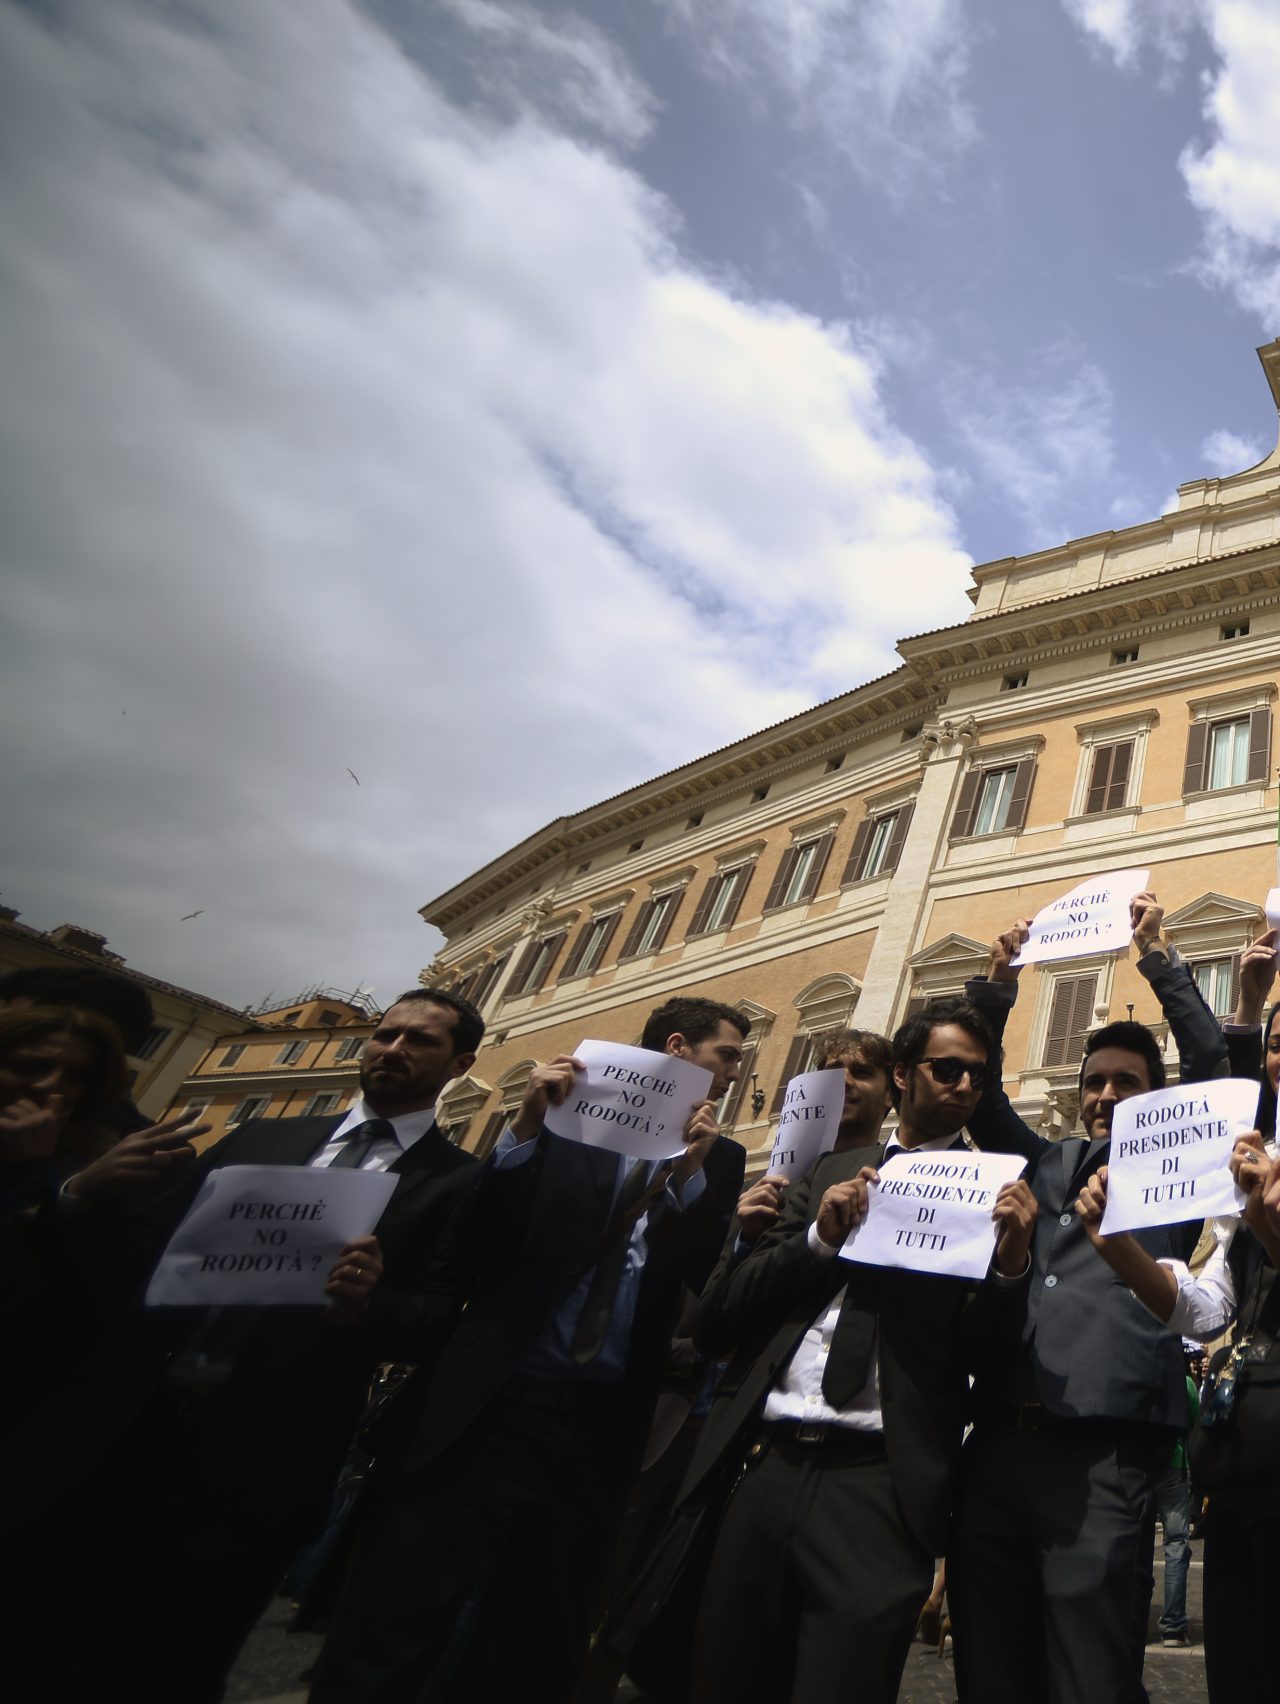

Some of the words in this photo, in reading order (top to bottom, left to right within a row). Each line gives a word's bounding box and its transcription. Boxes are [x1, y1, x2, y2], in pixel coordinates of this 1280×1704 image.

[1053, 889, 1111, 912] PERCHÈ
[1067, 911, 1089, 925] NO
[1040, 922, 1099, 945] RODOTÀ
[601, 1065, 677, 1098] PERCHÈ
[617, 1090, 646, 1108] NO
[574, 1100, 652, 1134] RODOTÀ
[655, 1124, 665, 1137] ?
[1135, 1094, 1210, 1130] RODOTÀ
[1119, 1119, 1229, 1159] PRESIDENTE
[907, 1162, 980, 1182] RODOTÀ
[1161, 1156, 1180, 1176] DI
[879, 1180, 991, 1206] PRESIDENTE
[1141, 1180, 1196, 1205] TUTTI
[227, 1199, 327, 1221] PERCHÈ
[916, 1207, 936, 1224] DI
[252, 1228, 287, 1246] NO
[895, 1229, 947, 1251] TUTTI
[200, 1251, 303, 1272] RODOTÀ
[311, 1255, 322, 1272] ?
